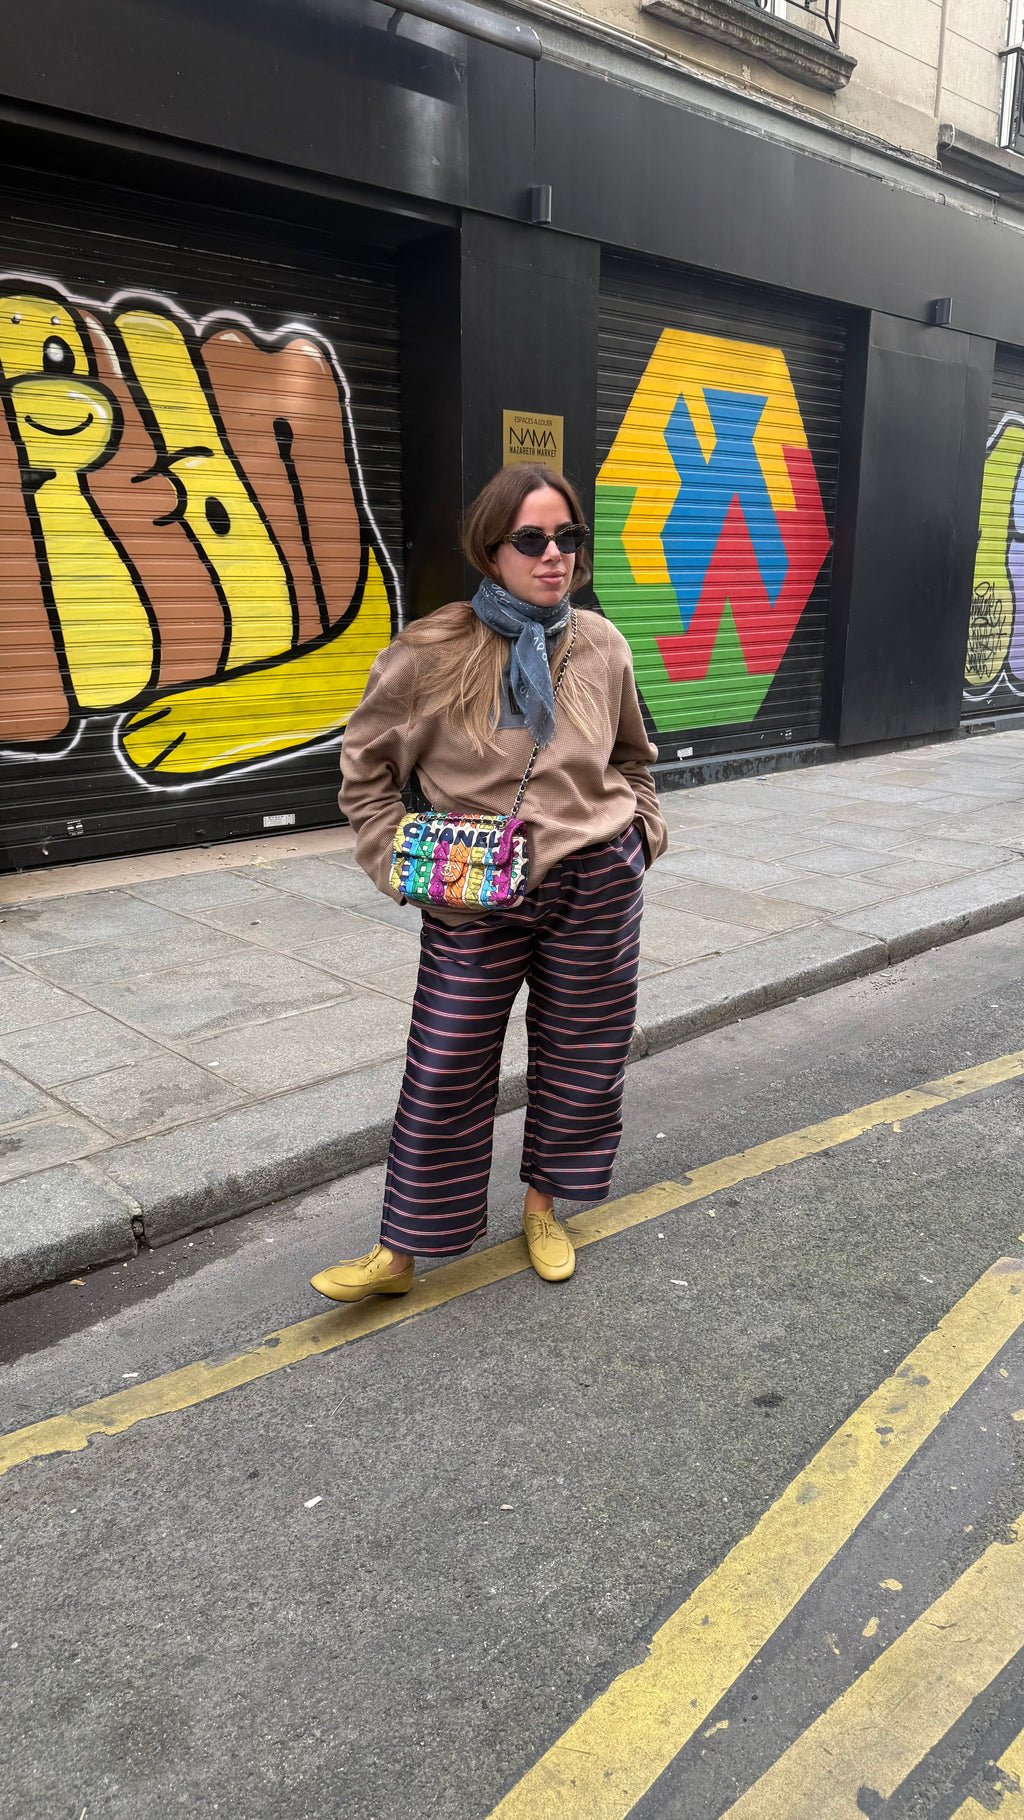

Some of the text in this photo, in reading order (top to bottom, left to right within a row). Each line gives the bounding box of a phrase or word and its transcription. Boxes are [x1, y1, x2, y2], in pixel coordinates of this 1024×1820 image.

[514, 416, 533, 424] ESPACES
[510, 426, 557, 449] NAMA
[510, 446, 557, 458] NAZARETH MARKET
[403, 822, 500, 848] CHANEL
